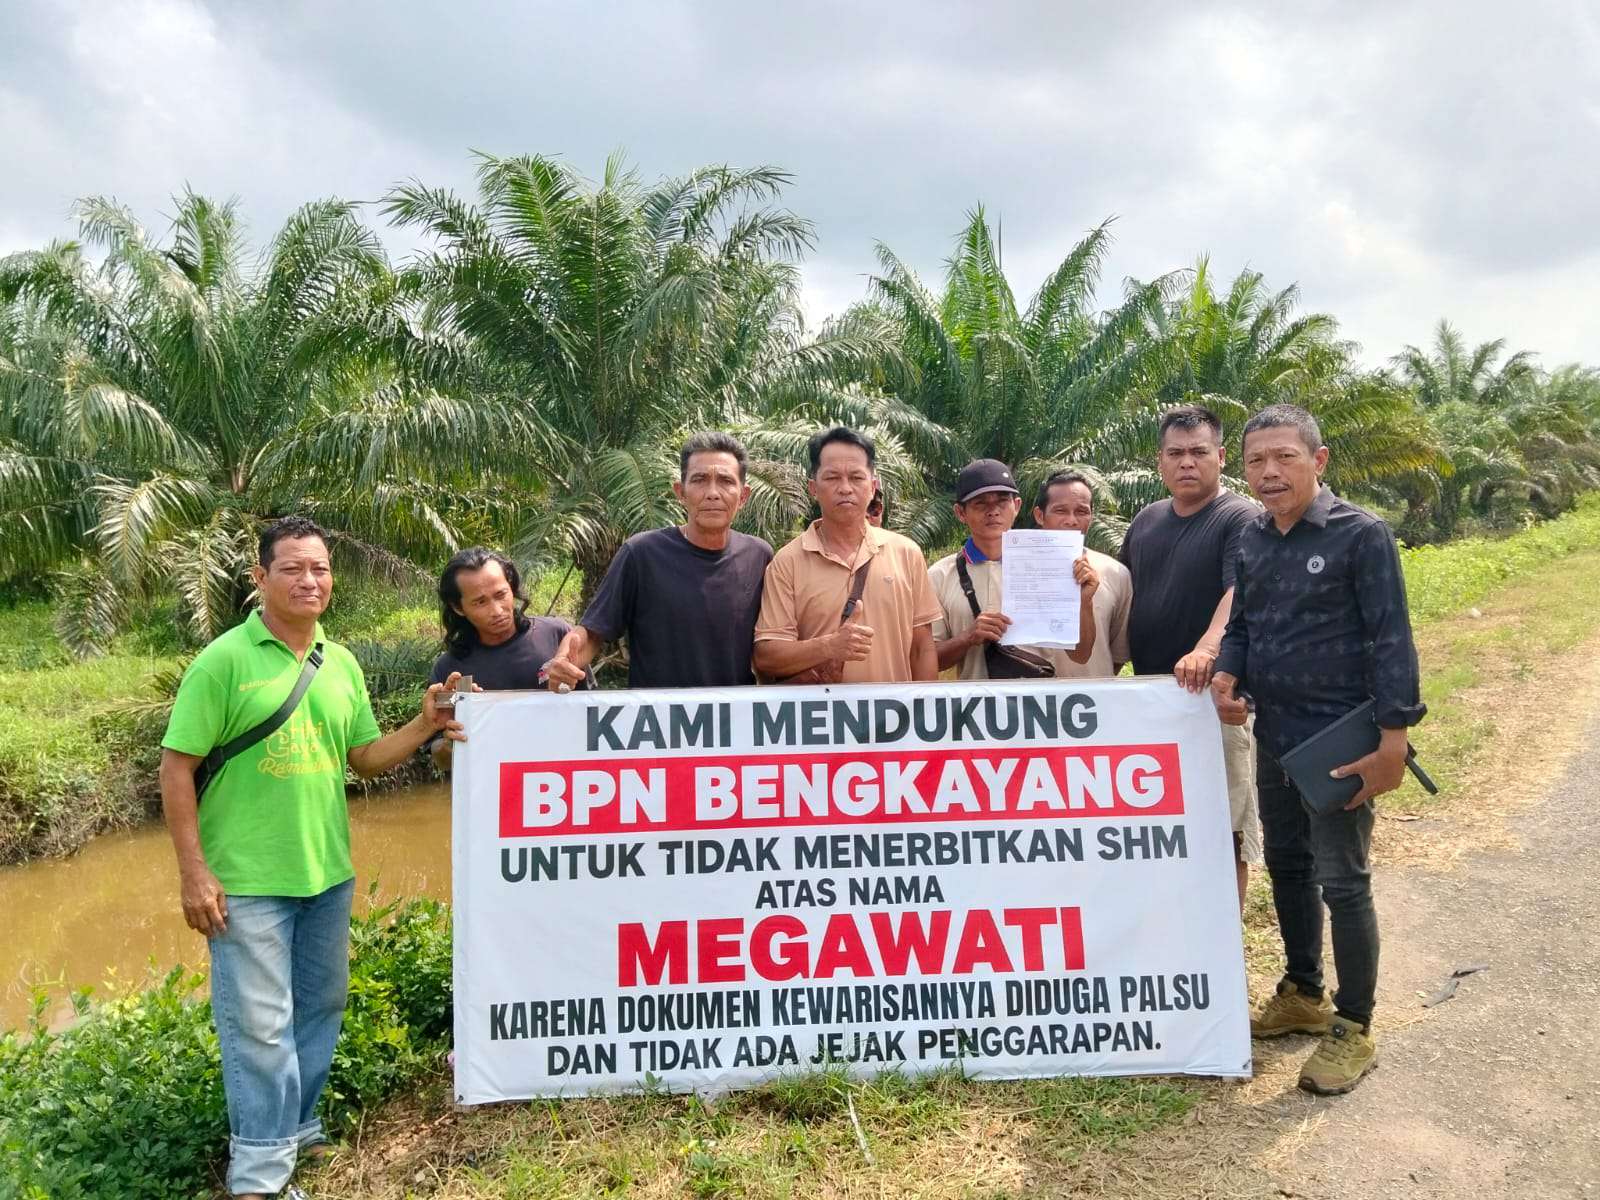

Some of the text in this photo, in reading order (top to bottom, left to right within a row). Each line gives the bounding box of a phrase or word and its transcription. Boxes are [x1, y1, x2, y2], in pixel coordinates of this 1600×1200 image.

[587, 694, 1097, 751] KAMI MENDUKUNG
[523, 754, 1165, 827] BPN BENGKAYANG
[502, 826, 1187, 882] UNTUK TIDAK MENERBITKAN SHM
[756, 876, 944, 908] ATAS NAMA
[619, 907, 1085, 987] MEGAWATI
[491, 974, 1209, 1040] KARENA DOKUMEN KEWARISANNYA DIDUGA PALSU
[548, 1021, 1162, 1075] DAN TIDAK ADA JEJAK PENGGARAPAN.
